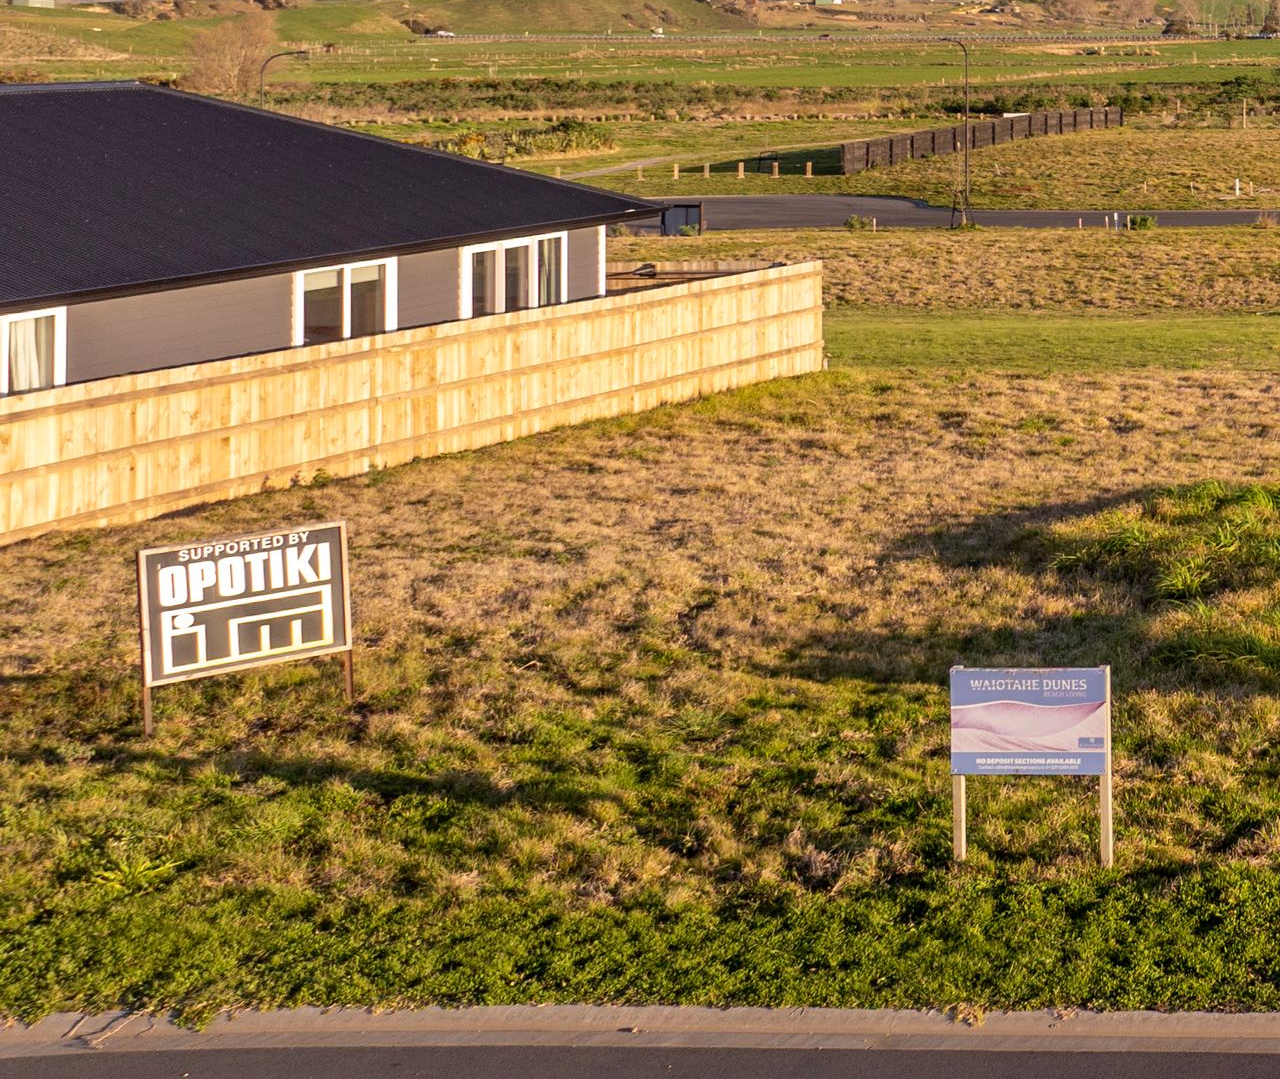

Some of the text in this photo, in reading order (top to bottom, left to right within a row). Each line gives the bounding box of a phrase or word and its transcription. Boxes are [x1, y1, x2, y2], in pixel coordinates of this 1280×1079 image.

[178, 531, 310, 562] SUPPORTED BY
[158, 542, 332, 607] OPOTIKI
[970, 679, 1087, 691] WAIOTAHE DUNES
